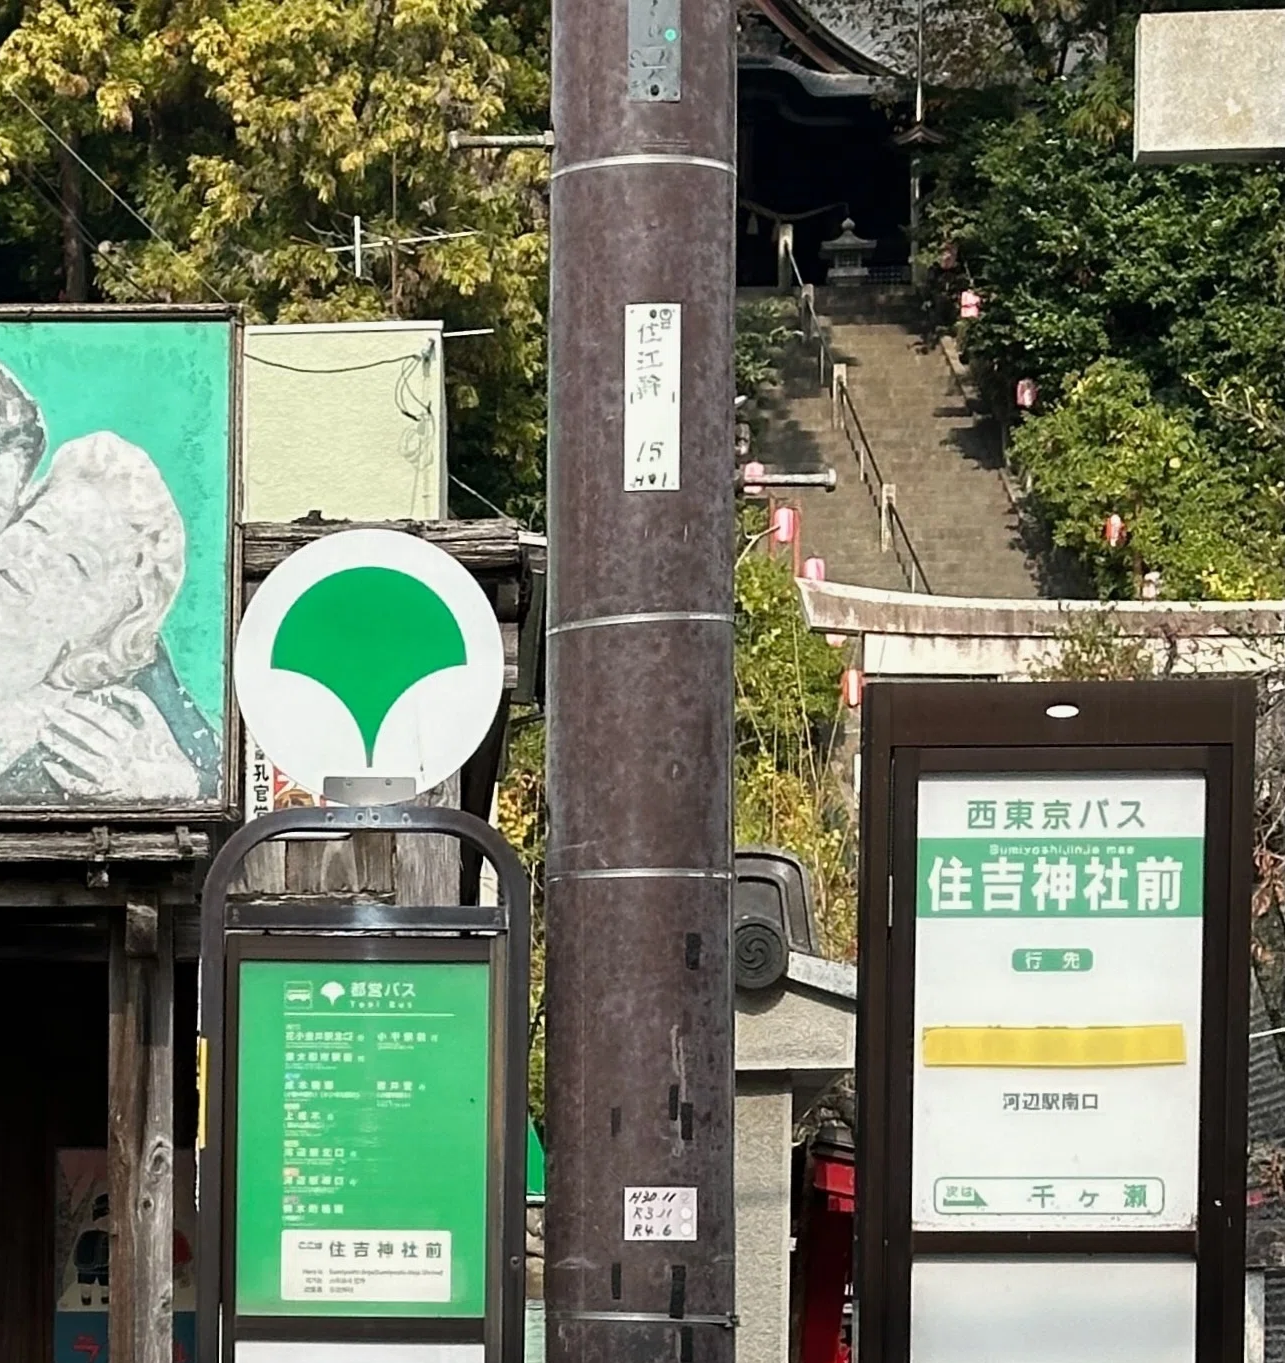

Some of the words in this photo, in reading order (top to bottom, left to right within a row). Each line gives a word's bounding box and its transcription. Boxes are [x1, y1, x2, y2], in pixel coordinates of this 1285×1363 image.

[966, 798, 1146, 831] 西東京バス
[927, 855, 1184, 912] 住吉神社前
[1024, 951, 1081, 970] 行先
[350, 981, 416, 998] 都営バス
[1002, 1092, 1099, 1111] 河辺駅南口
[945, 1185, 973, 1198] 次は
[329, 1240, 443, 1259] 住吉神社前
